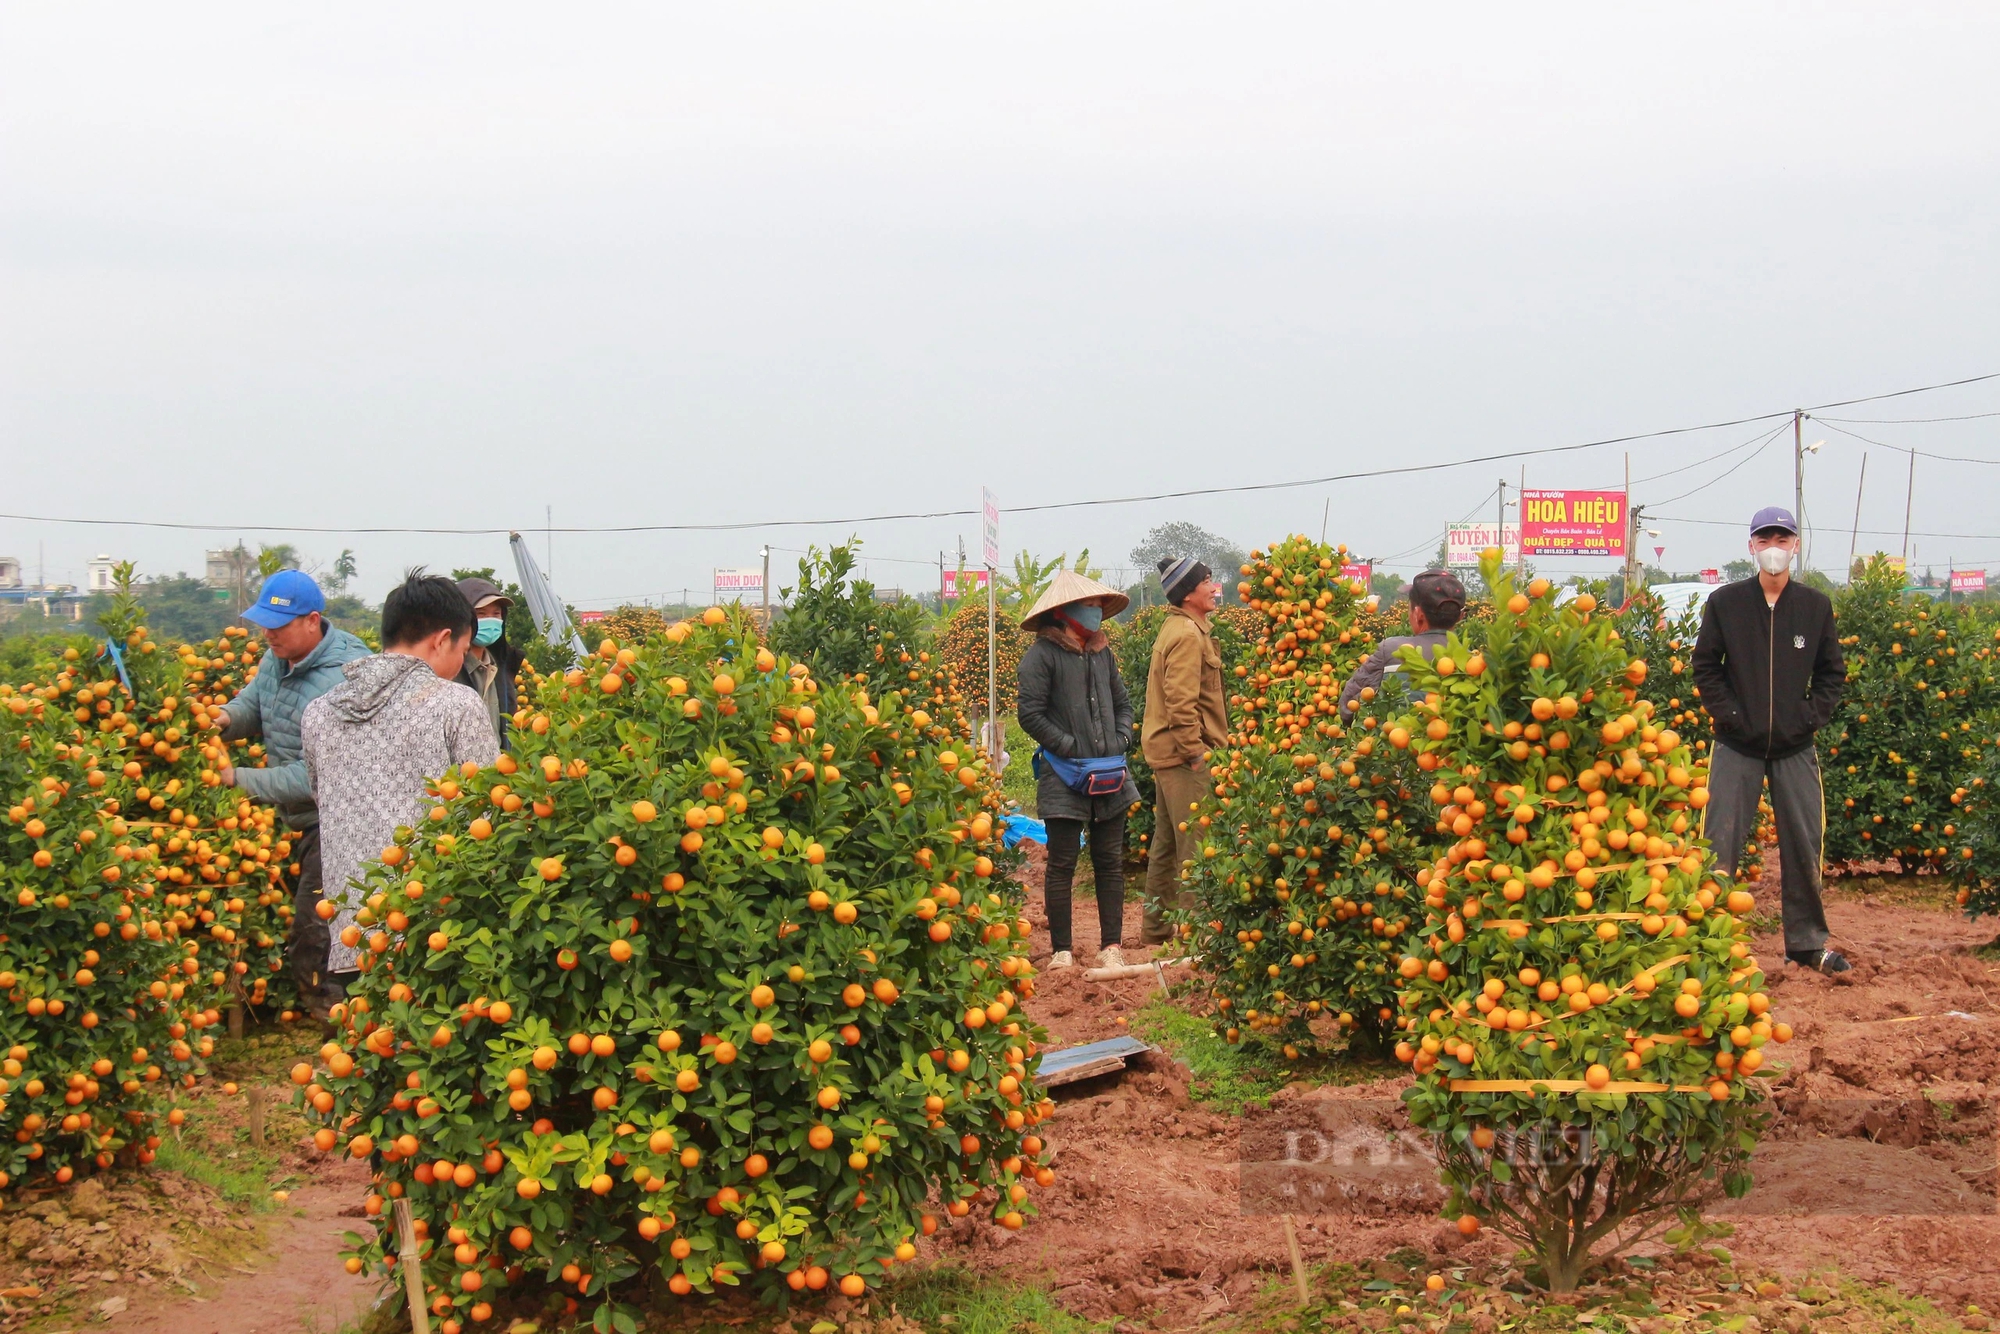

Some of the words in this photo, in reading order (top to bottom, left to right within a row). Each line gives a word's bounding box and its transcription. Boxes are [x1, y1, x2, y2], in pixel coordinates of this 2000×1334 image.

[1524, 490, 1540, 499] NHÀ
[1542, 490, 1565, 499] VƯỜN
[1527, 500, 1567, 523] HOA
[1573, 496, 1619, 528] HIỆU
[1450, 523, 1490, 545] TUYẾN
[1523, 534, 1550, 547] QUẤT
[1553, 537, 1574, 548] ĐẸP
[1584, 535, 1605, 548] QUẢ
[1608, 538, 1621, 547] TO
[743, 575, 762, 586] DUY
[1963, 577, 1984, 586] OANH
